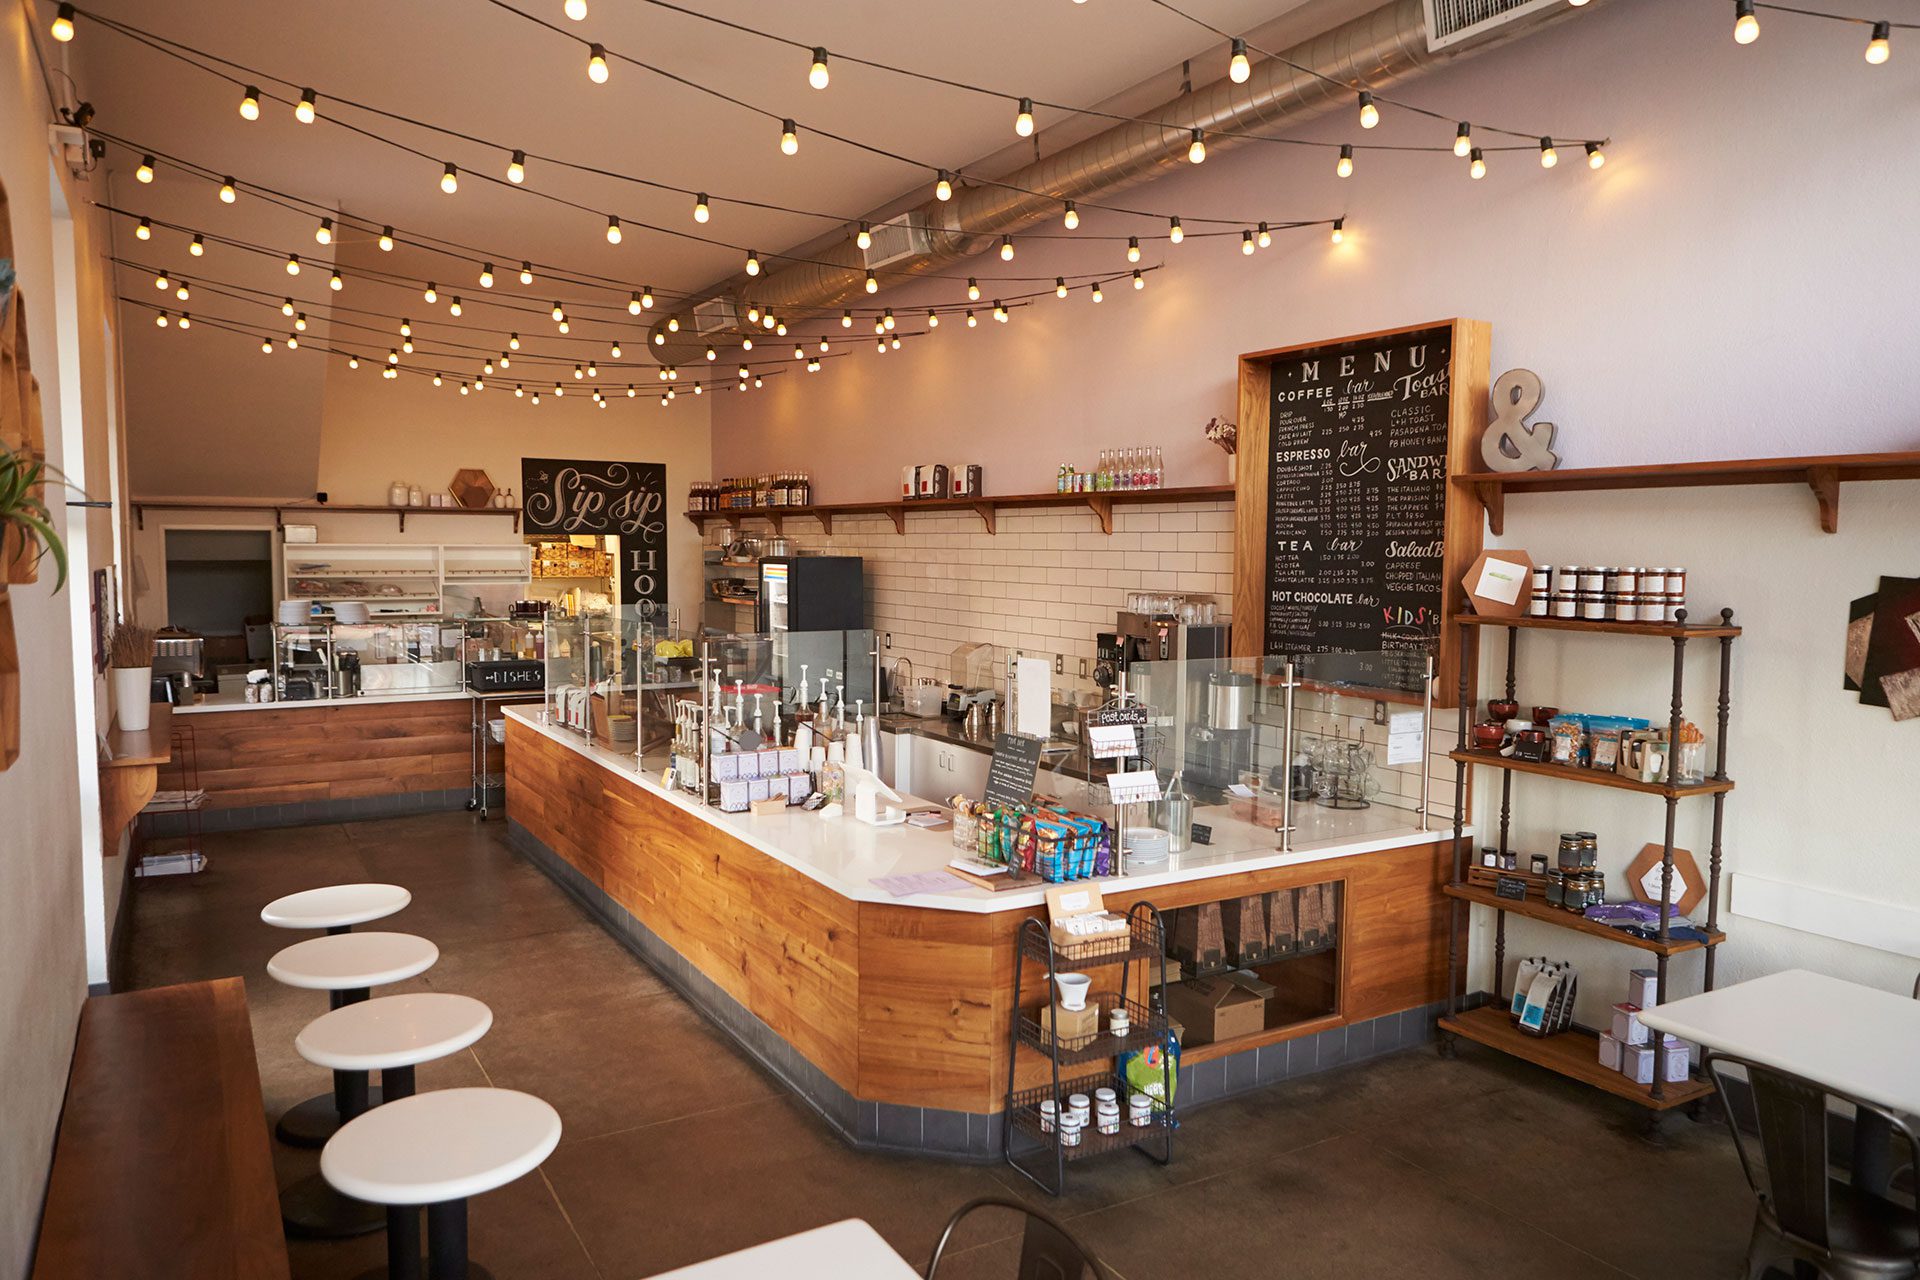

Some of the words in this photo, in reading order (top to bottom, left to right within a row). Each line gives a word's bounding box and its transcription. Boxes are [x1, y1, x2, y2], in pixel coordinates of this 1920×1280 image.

[1301, 344, 1427, 383] MENU
[1278, 386, 1333, 402] COFFEE
[1343, 379, 1375, 394] bar
[1420, 382, 1450, 399] BAR
[1391, 404, 1431, 418] CLASSIC
[1409, 414, 1435, 424] TOAST
[1390, 424, 1430, 437] PASADENA
[1400, 436, 1425, 448] HONEY
[1276, 447, 1331, 463] ESPRESSO
[1409, 468, 1446, 481] BAR
[1400, 485, 1431, 493] ITALIANO
[526, 463, 630, 532] Sip
[1400, 494, 1430, 502] PARISIAN
[608, 486, 664, 544] sip
[1278, 540, 1313, 551] TEA
[1326, 537, 1363, 551] bar
[1385, 540, 1435, 558] Salad
[1288, 553, 1299, 561] TEA
[1385, 561, 1421, 570] CAPRESE
[1385, 571, 1414, 580] CHOPPED
[1386, 582, 1414, 592] VEGGIE
[1272, 590, 1292, 602] HOT
[1294, 591, 1353, 605] CHOCOLATE
[1433, 614, 1442, 625] B
[1285, 642, 1311, 653] STEAMER
[1381, 640, 1417, 651] BIRTHDAY
[493, 670, 541, 683] DISHES
